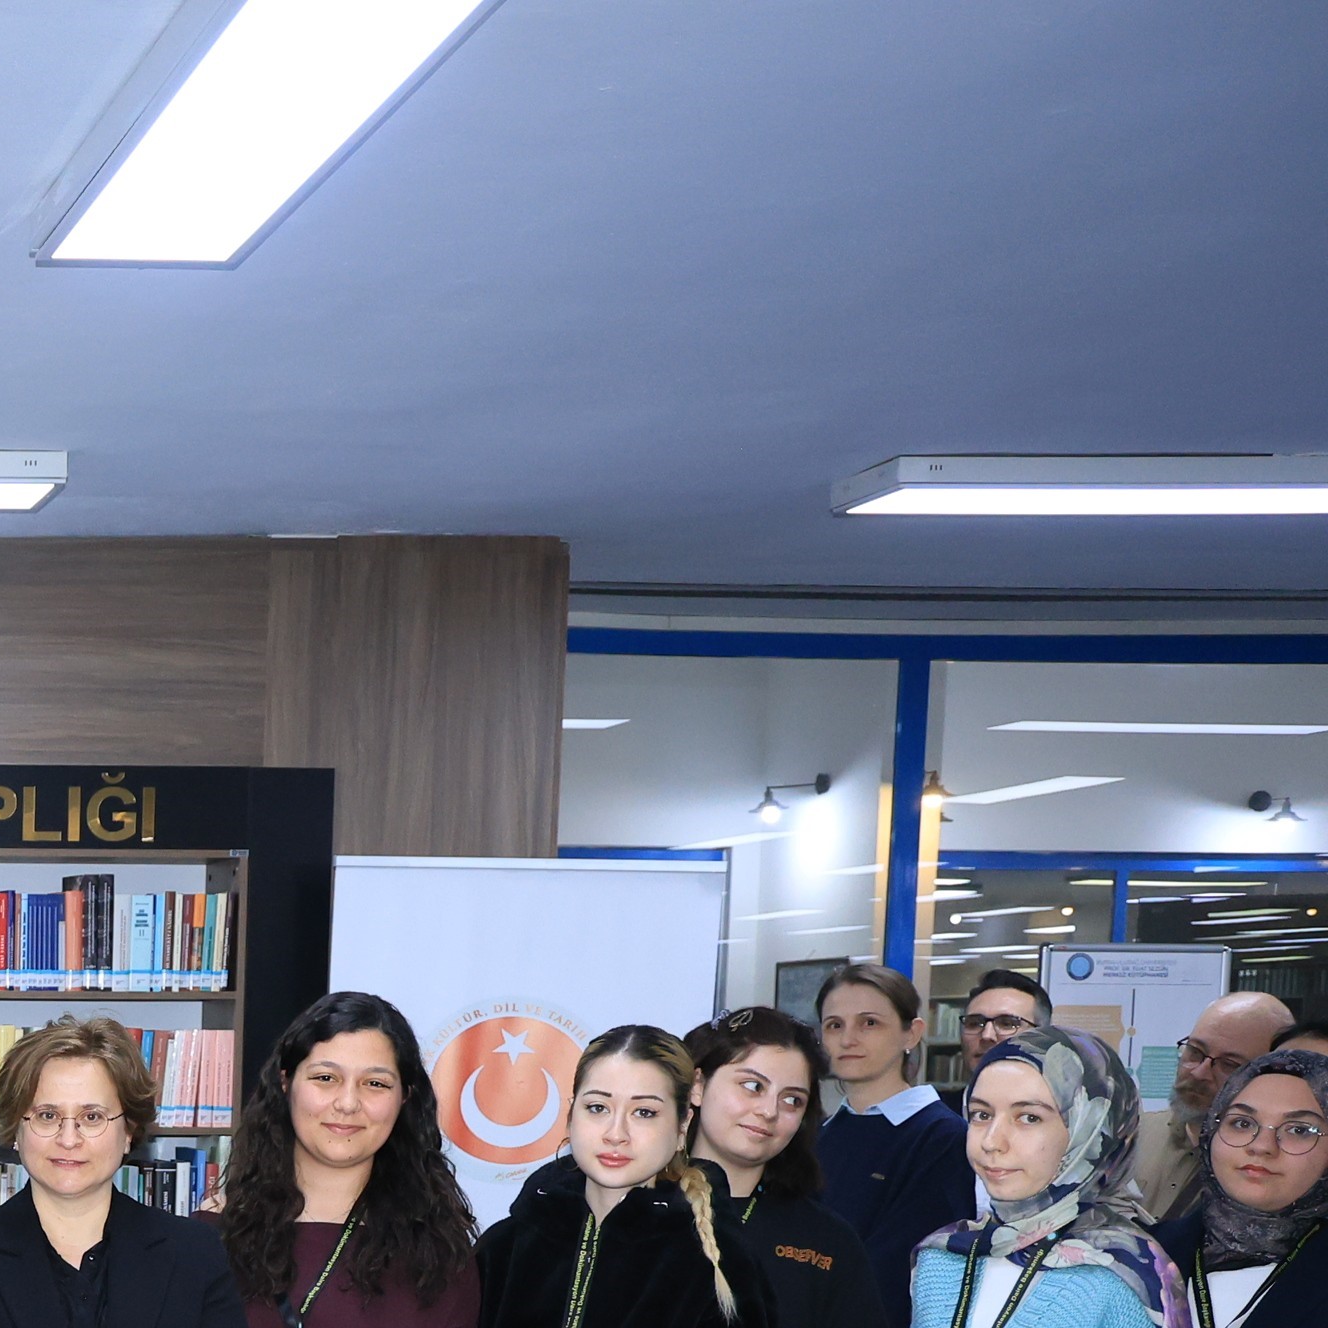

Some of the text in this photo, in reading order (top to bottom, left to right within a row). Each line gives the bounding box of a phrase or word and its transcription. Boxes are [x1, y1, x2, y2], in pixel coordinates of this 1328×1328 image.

[494, 1003, 519, 1014] DİL
[1011, 1283, 1024, 1302] Daire
[1019, 1248, 1044, 1283] Başkanlığı
